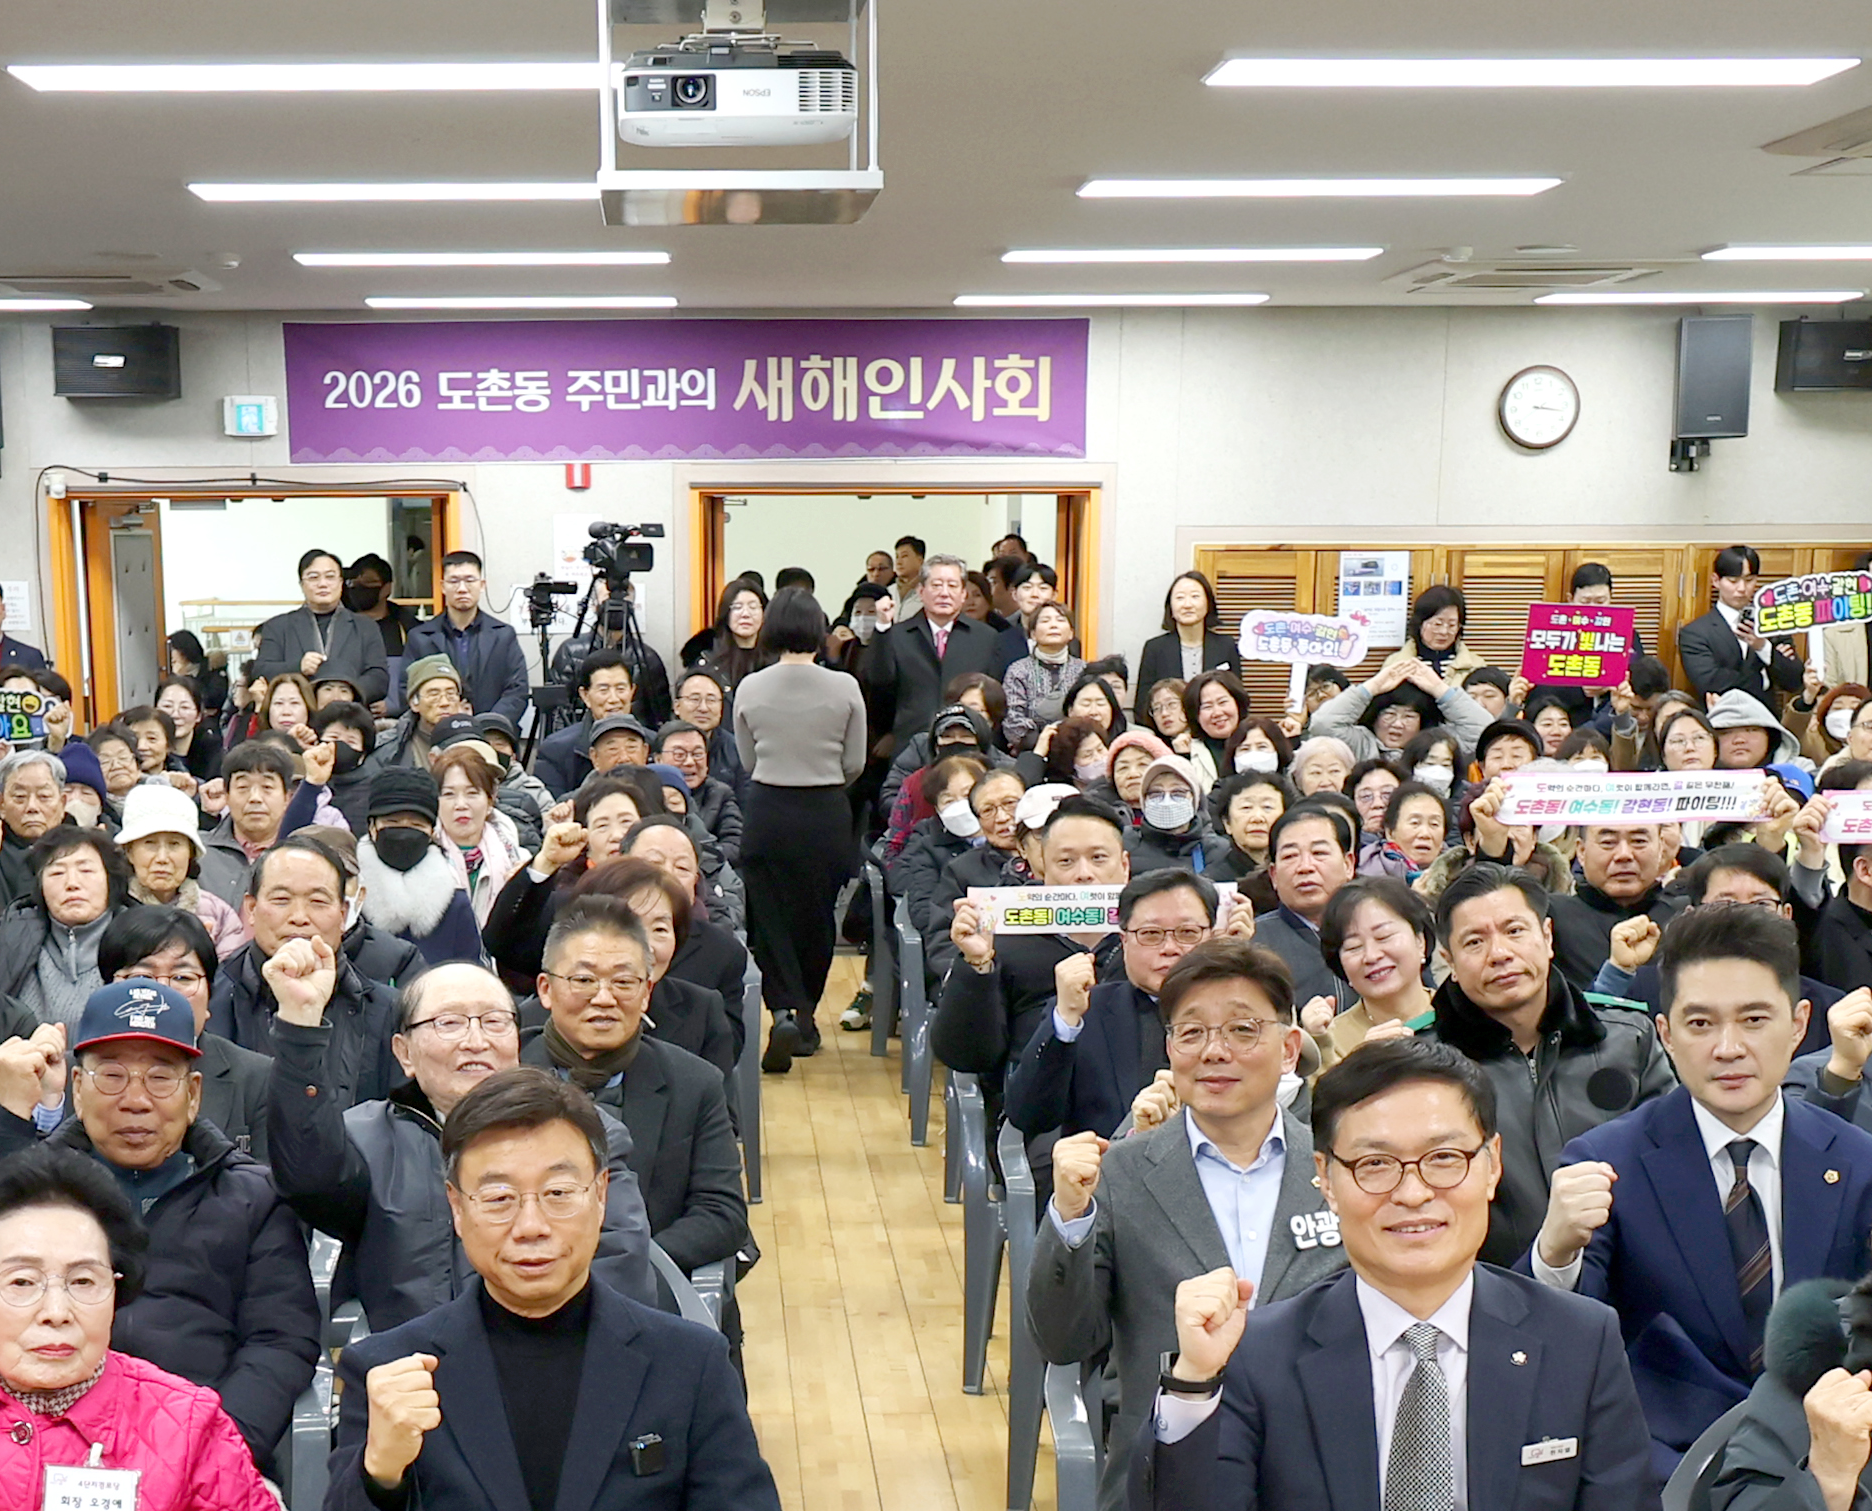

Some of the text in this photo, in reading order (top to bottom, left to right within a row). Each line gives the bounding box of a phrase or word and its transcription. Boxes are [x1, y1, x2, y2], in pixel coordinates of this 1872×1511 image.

[742, 88, 771, 97] EPSON
[323, 355, 1054, 423] 2026 도촌동 주민과의 새해인사회
[1759, 592, 1872, 633] 도촌동 파이팅!
[1529, 629, 1626, 653] 모두가 빛나는
[1546, 653, 1602, 679] 도촌동
[1514, 796, 1738, 815] 도촌동! 여수동! 갈현동! 파이팅!!!
[1004, 907, 1053, 926] 도촌동!
[1055, 907, 1104, 926] 여수동!
[1290, 1210, 1342, 1249] 안광
[60, 1495, 82, 1509] 회장
